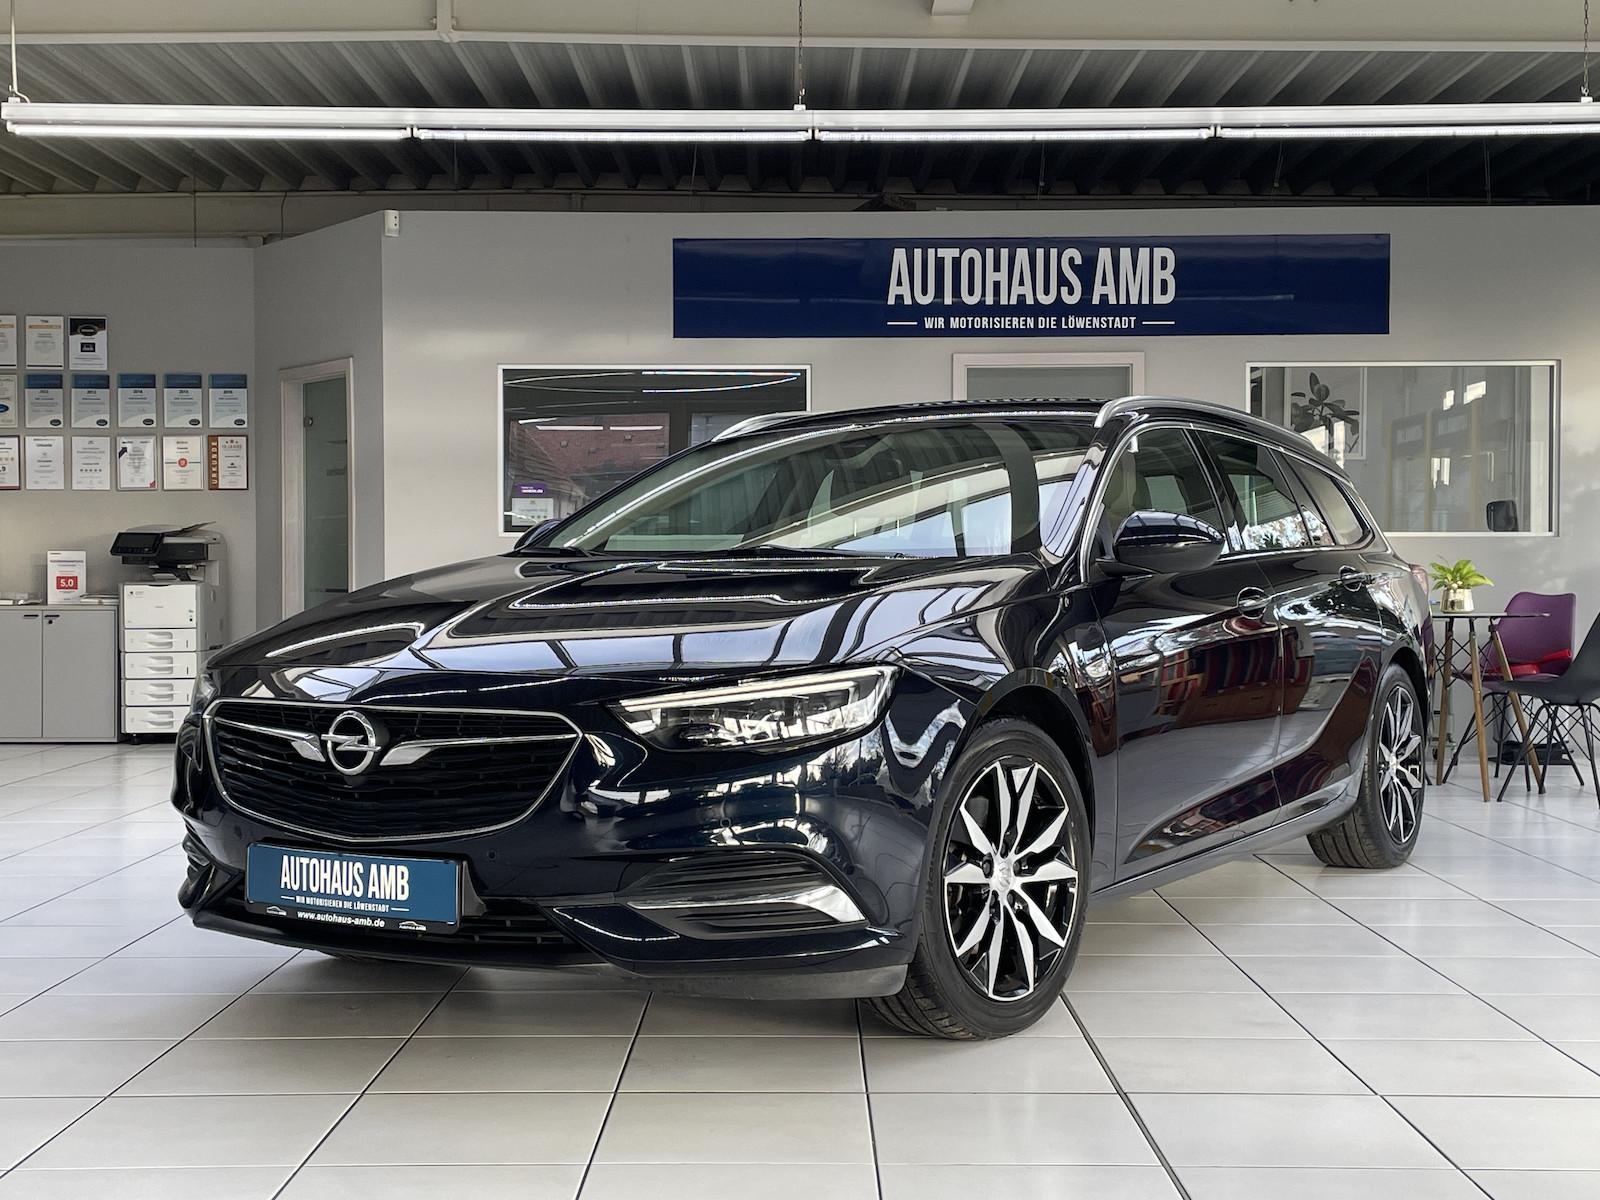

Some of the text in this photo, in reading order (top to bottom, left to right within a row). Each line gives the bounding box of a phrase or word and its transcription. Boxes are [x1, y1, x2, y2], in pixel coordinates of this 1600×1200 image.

[887, 247, 1177, 305] AUTOHAUS AMB
[924, 315, 1136, 329] WIR MOTORISIEREN DIE LÖWENSTADT
[280, 854, 410, 901] AUTOHAUS AMB
[297, 911, 385, 928] www.autohaus-amb.de
